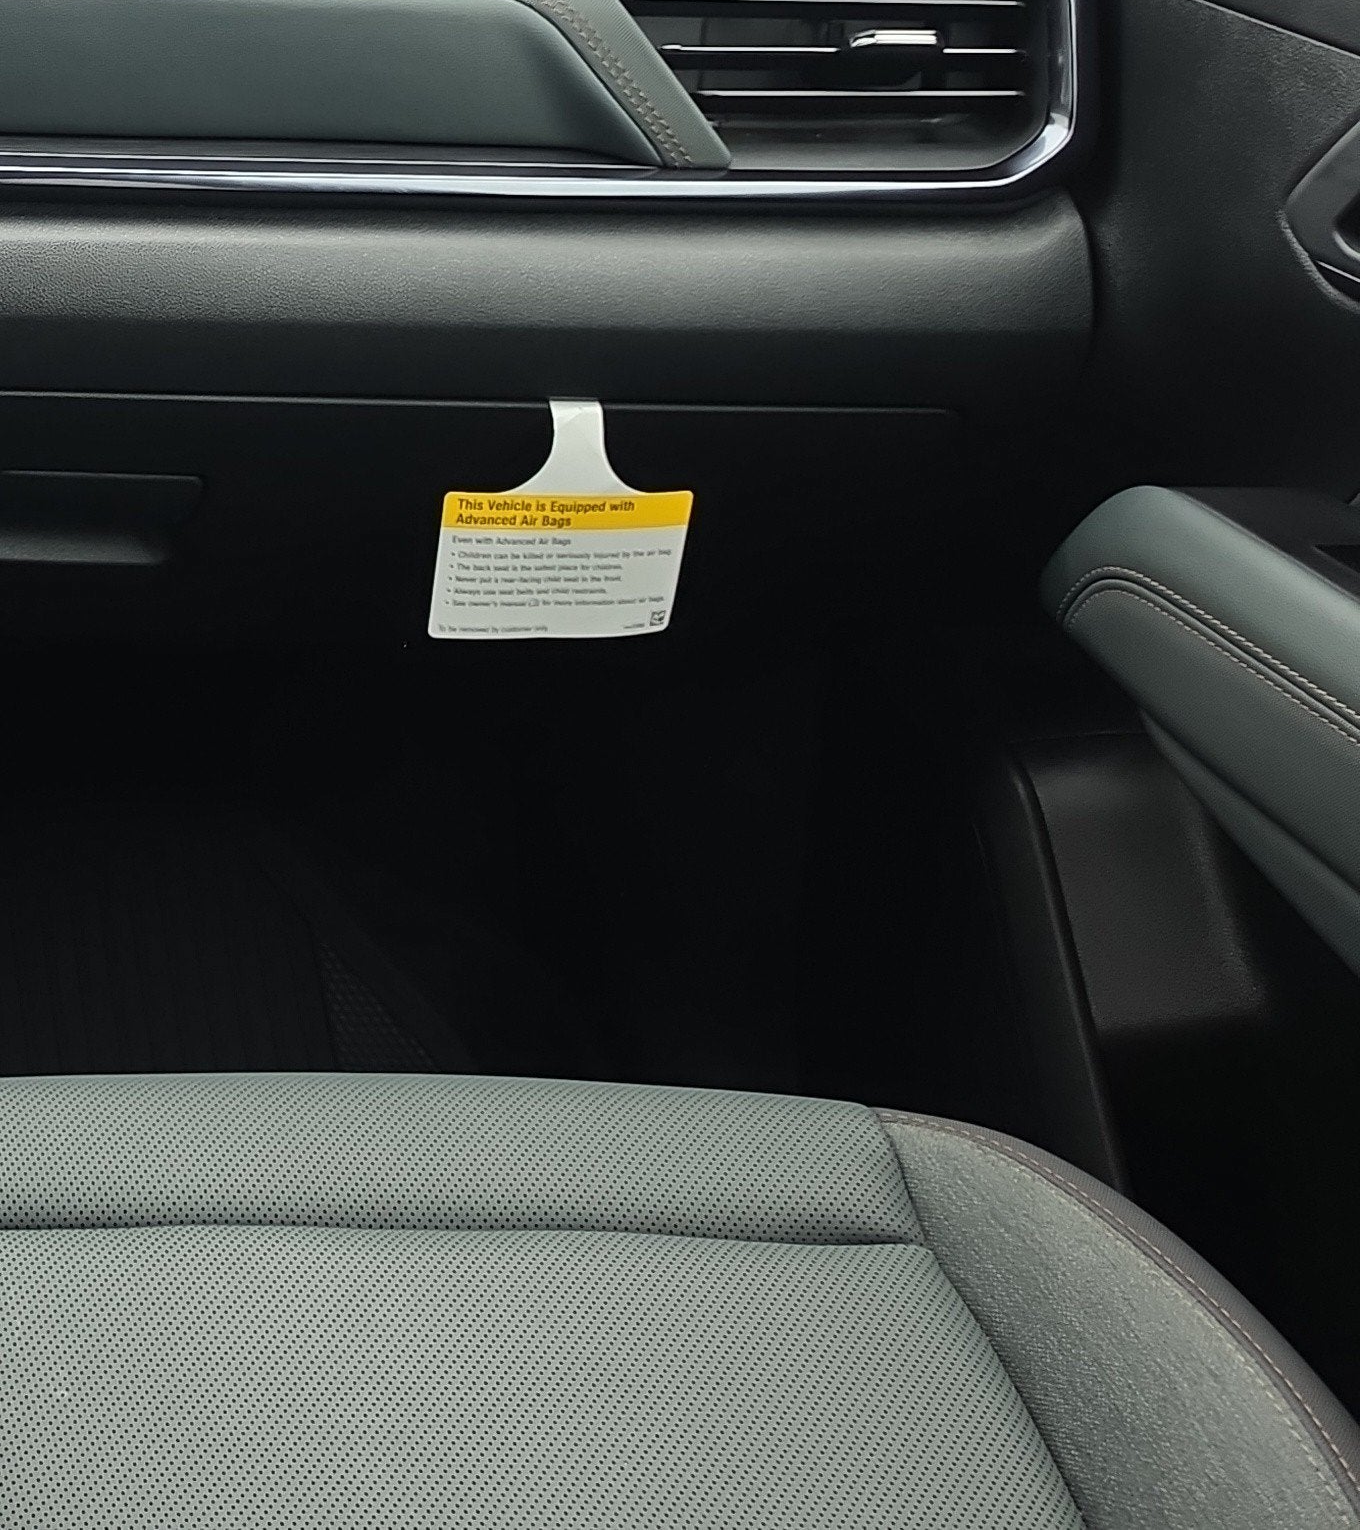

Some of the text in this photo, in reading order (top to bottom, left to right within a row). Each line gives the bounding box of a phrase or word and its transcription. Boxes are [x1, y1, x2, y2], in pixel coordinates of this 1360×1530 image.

[458, 499, 635, 514] This Vehicle is Equipped with
[456, 513, 571, 528] Advanced Air Bags
